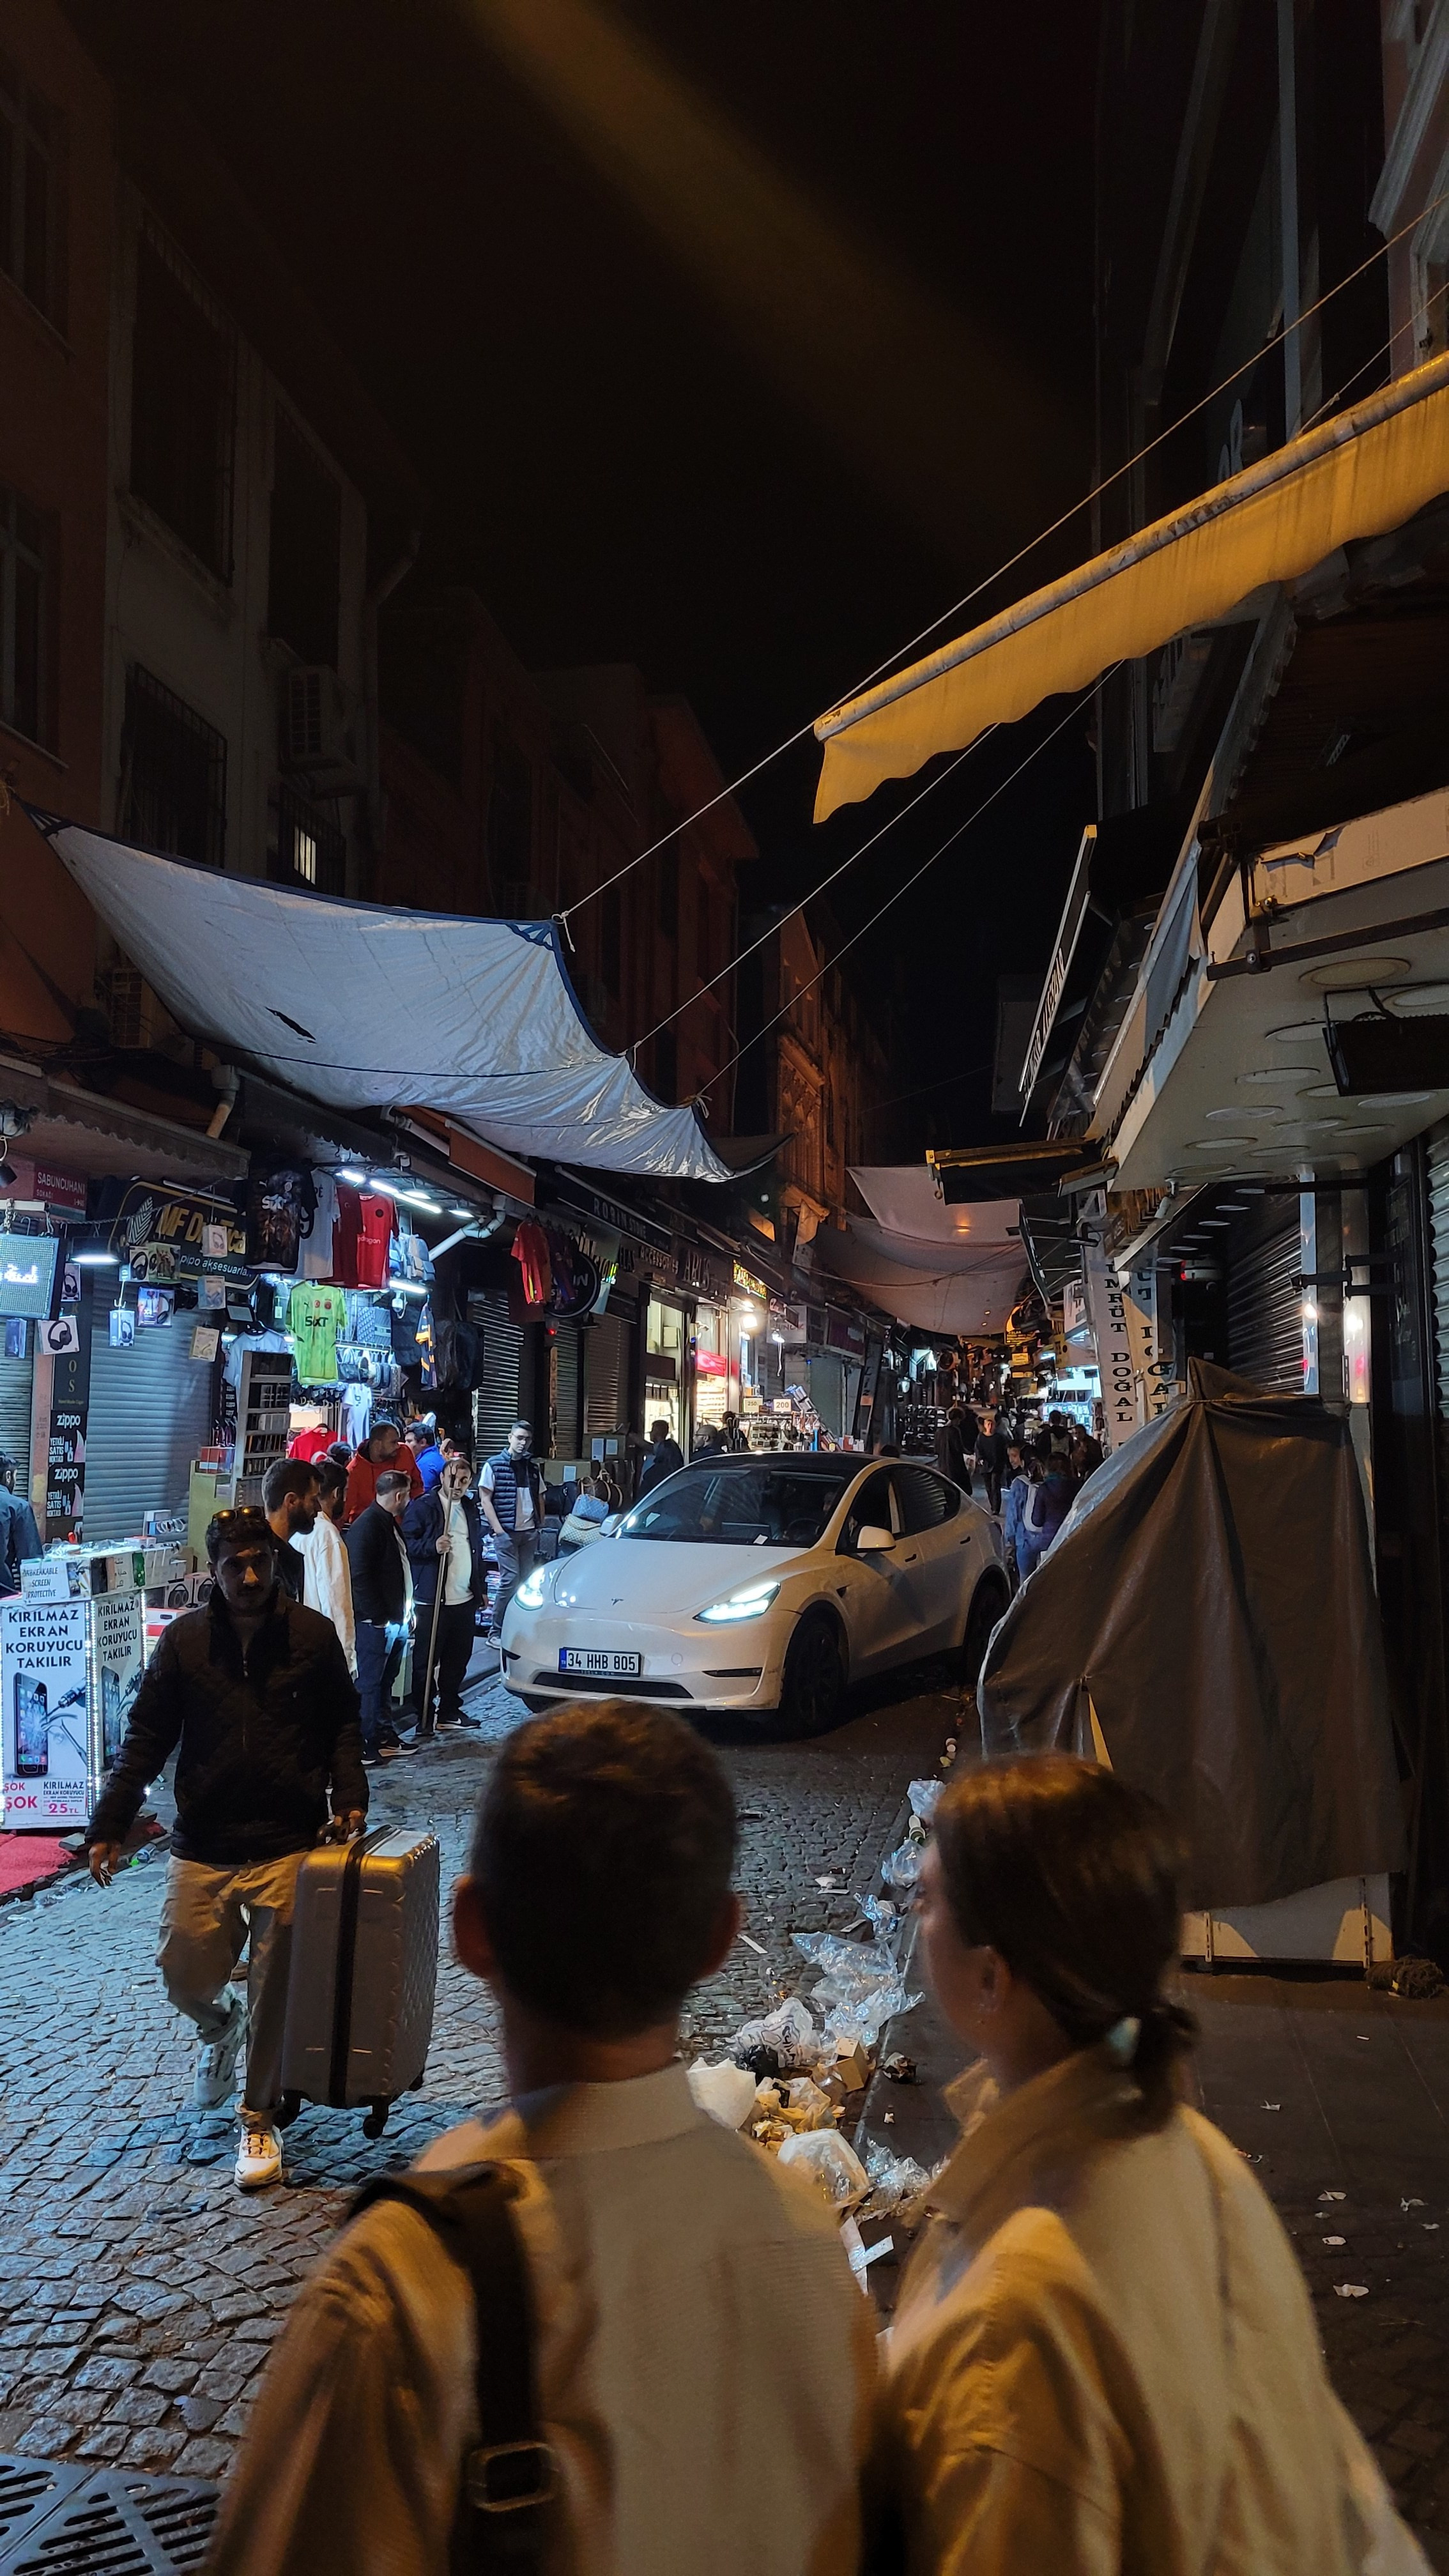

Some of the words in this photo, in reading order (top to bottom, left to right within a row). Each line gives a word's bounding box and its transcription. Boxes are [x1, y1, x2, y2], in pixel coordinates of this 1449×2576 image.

[356, 1234, 381, 1245] pdragon
[305, 1315, 328, 1328] SIXT
[1111, 1352, 1133, 1422] DOĞAL
[56, 1413, 81, 1429] zippo
[54, 1467, 79, 1482] zippo
[9, 1609, 79, 1623] KIRILMAZ
[98, 1600, 135, 1617] KIRILMAZ
[20, 1625, 68, 1637] EKRAN
[103, 1616, 130, 1631] EKRAN
[97, 1629, 137, 1648] KORUYUCU
[6, 1640, 83, 1653] KORUYUCU
[103, 1645, 132, 1662] TAKILIR
[17, 1656, 72, 1669] TAKILIR
[567, 1653, 582, 1667] 34
[587, 1653, 608, 1669] HHB
[613, 1655, 636, 1671] 805
[5, 1796, 38, 1813] ŞOK
